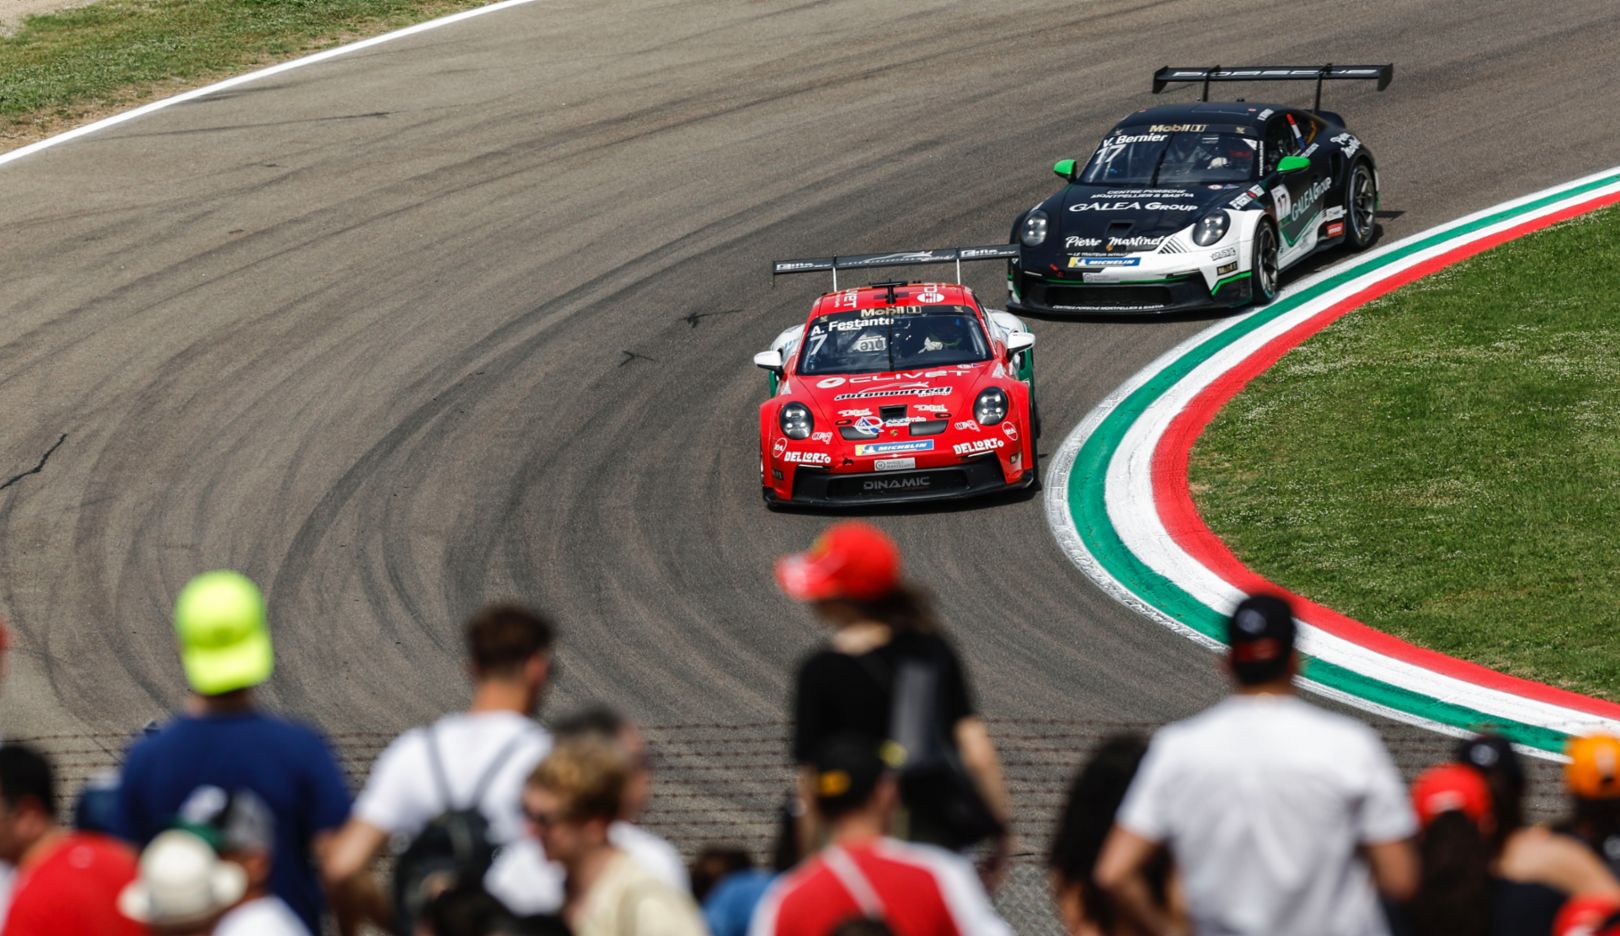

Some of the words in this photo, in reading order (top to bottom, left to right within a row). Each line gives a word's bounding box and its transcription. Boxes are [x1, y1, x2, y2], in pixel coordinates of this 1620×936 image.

[1149, 124, 1191, 133] Mobil
[1103, 138, 1113, 148] V.
[1116, 133, 1168, 144] Bernier
[1095, 144, 1127, 165] 17
[1069, 202, 1141, 212] GALEA
[861, 306, 905, 318] Mobil
[810, 325, 825, 336] A.
[828, 318, 894, 331] Festante
[810, 334, 828, 355] 7
[849, 370, 971, 384] CLIVET
[878, 443, 928, 451] MICHELIN
[863, 476, 931, 490] DINAMIC
